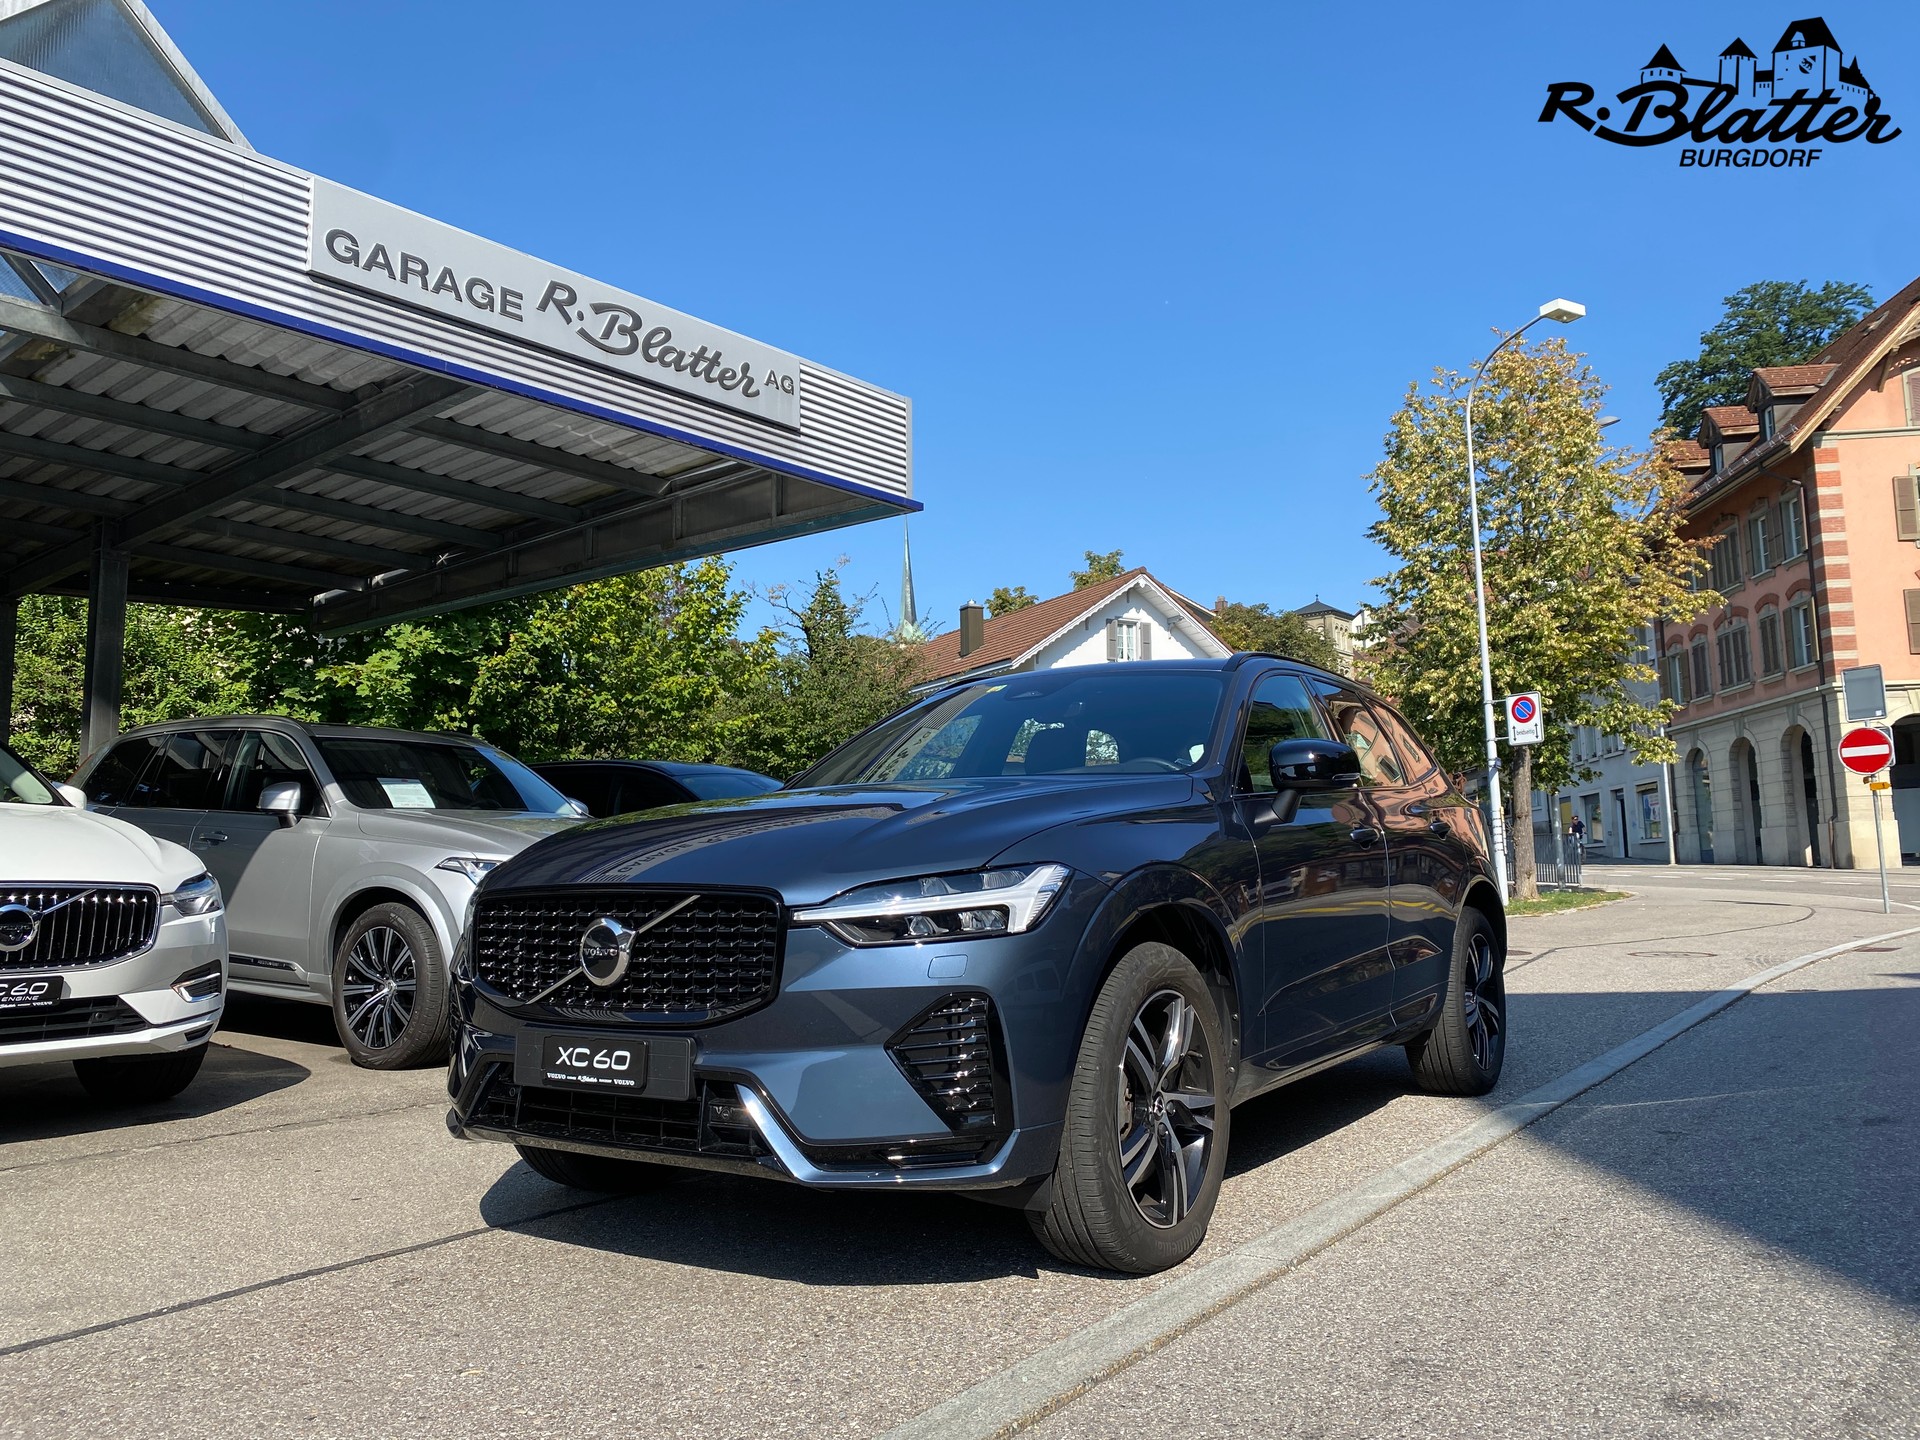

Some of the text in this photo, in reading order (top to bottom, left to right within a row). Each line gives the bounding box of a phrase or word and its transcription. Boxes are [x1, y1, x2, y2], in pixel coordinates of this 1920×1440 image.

[325, 228, 524, 322] GARAGE
[763, 369, 795, 396] AG
[583, 947, 618, 957] VOLVO
[546, 1072, 567, 1080] VOLVO
[613, 1078, 635, 1086] VOLVO
